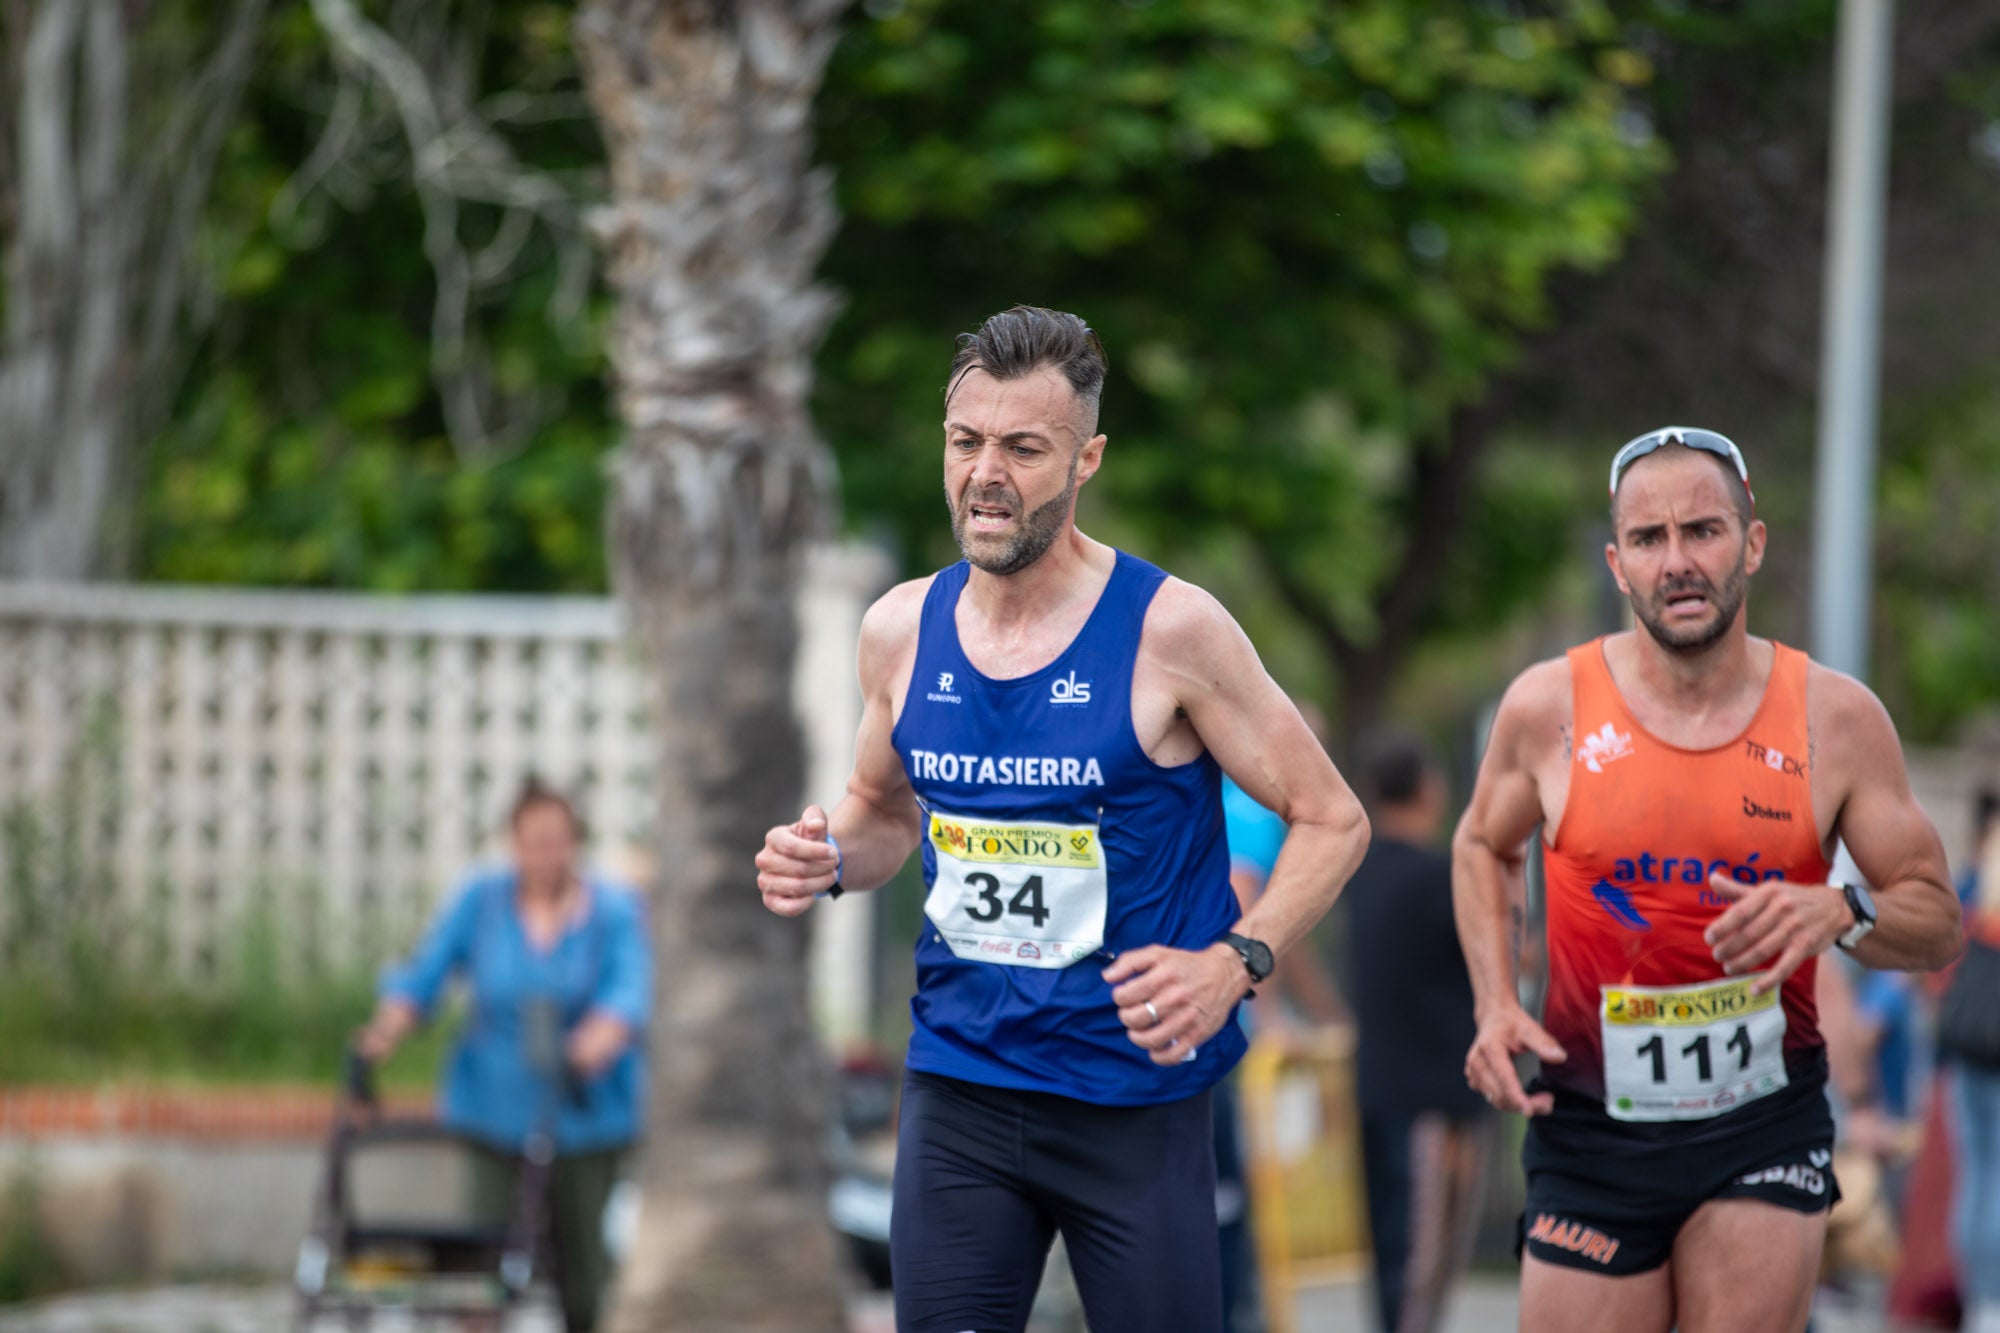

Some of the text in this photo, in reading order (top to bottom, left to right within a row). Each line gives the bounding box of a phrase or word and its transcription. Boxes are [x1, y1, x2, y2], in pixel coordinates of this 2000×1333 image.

[911, 750, 1105, 786] TROTASIERRA
[1746, 740, 1807, 780] TRACK
[944, 825, 967, 850] 38
[966, 836, 1061, 859] FONDO
[971, 827, 1004, 839] GRAN
[1007, 829, 1053, 841] PREMIO
[964, 872, 1050, 928] 34
[1628, 997, 1657, 1019] 38
[1637, 1025, 1753, 1083] 111
[1528, 1212, 1620, 1265] MAURI
